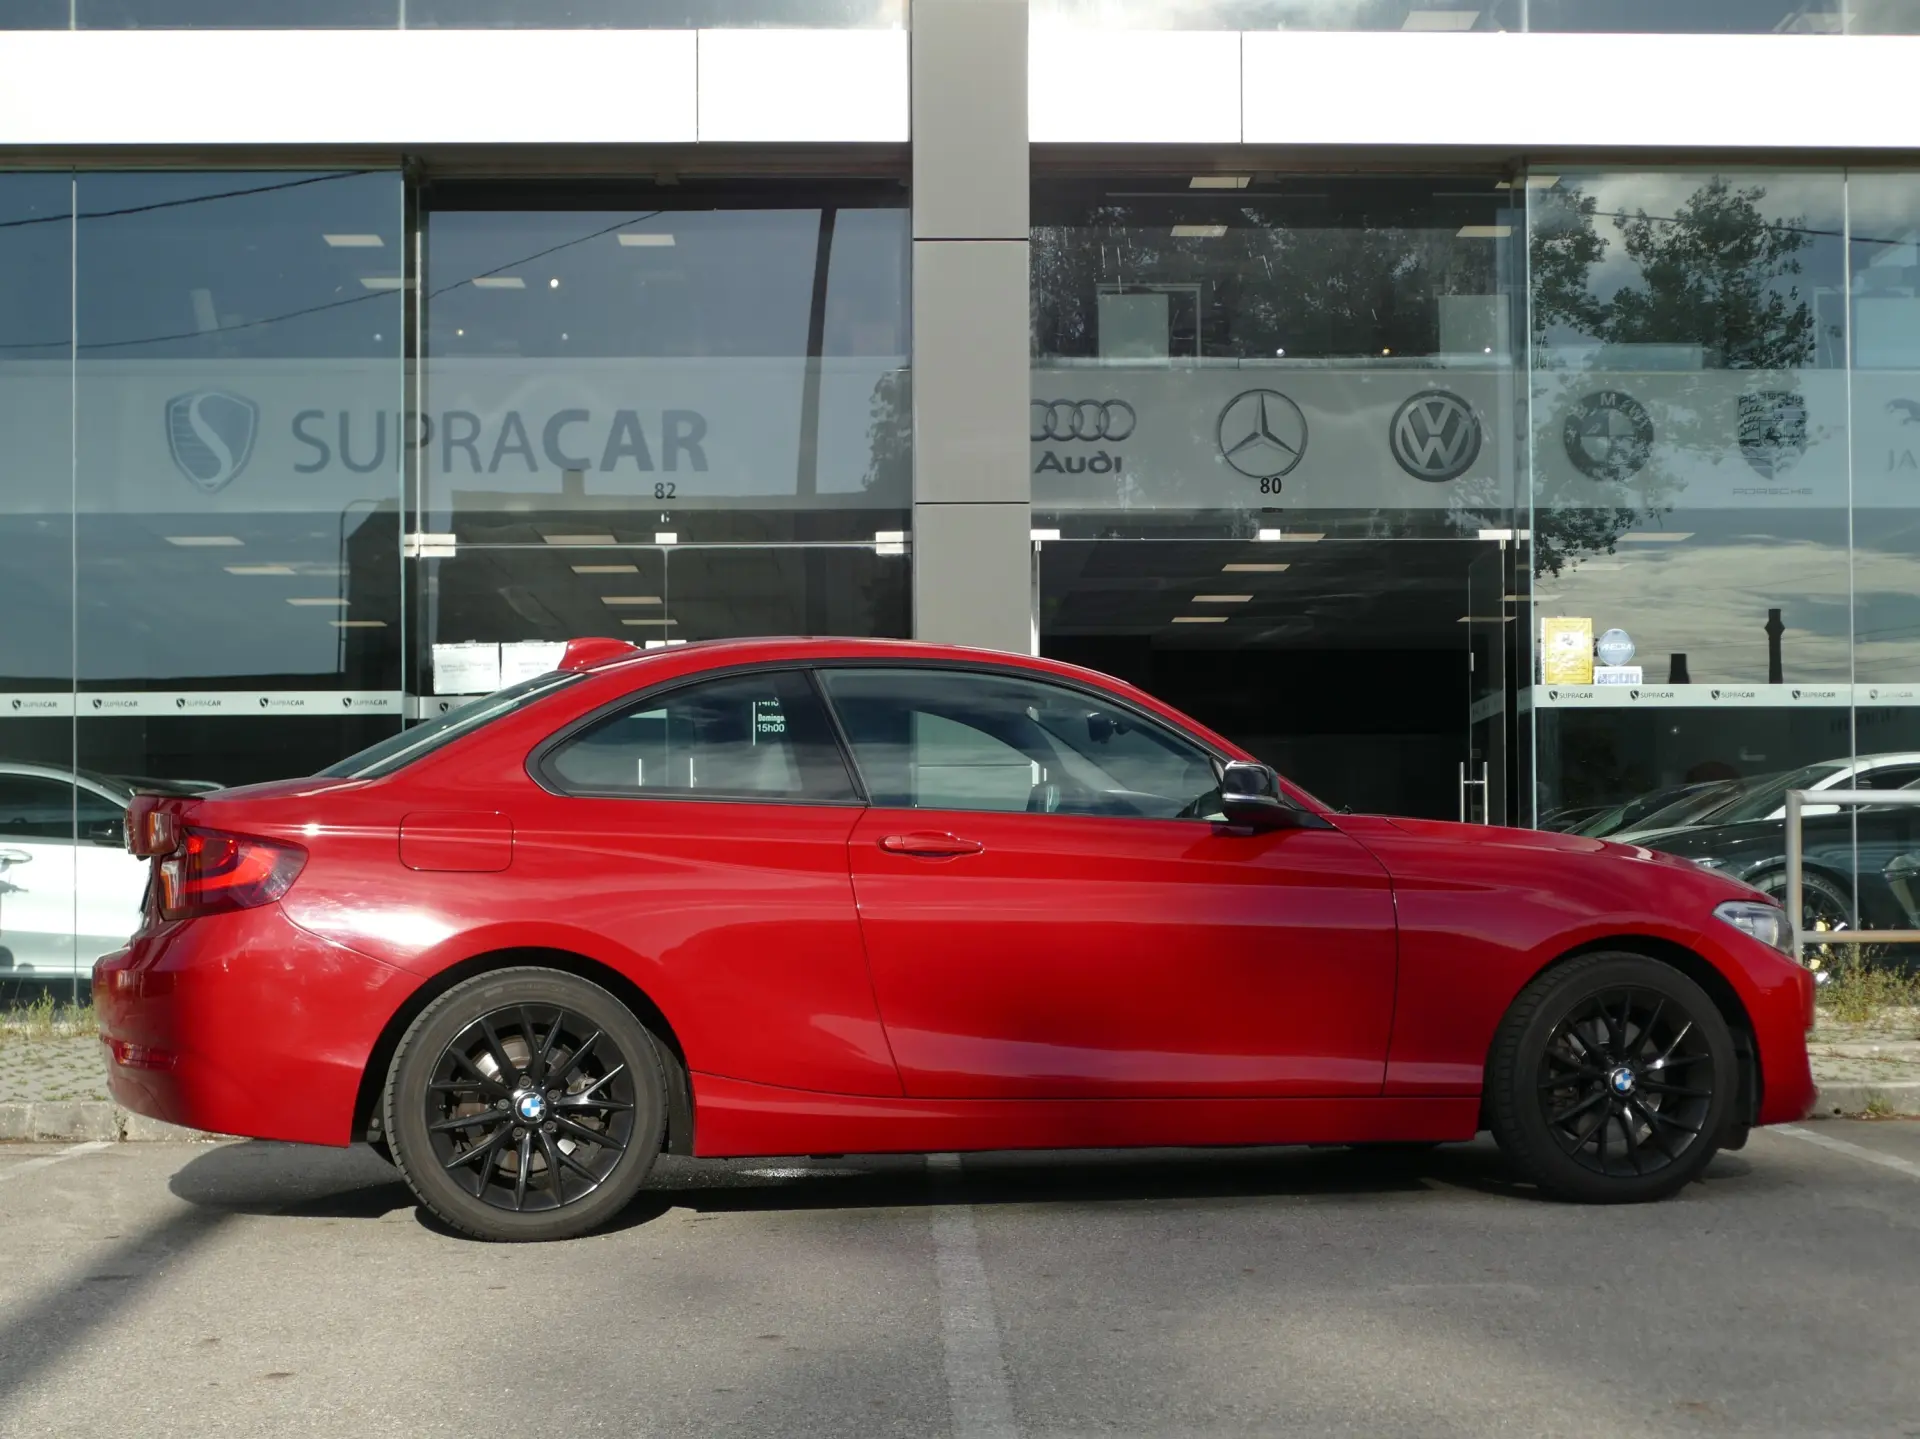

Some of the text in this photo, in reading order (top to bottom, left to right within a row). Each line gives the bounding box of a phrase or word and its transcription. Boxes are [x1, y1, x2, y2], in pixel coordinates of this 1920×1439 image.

[292, 408, 709, 473] SUPRACAR
[1034, 450, 1122, 474] Audi
[654, 482, 676, 499] 82
[1260, 477, 1282, 494] 80
[1720, 691, 1756, 699] SUPRACAR
[1802, 691, 1837, 699] SUPRACAR
[757, 723, 785, 732] 15h00
